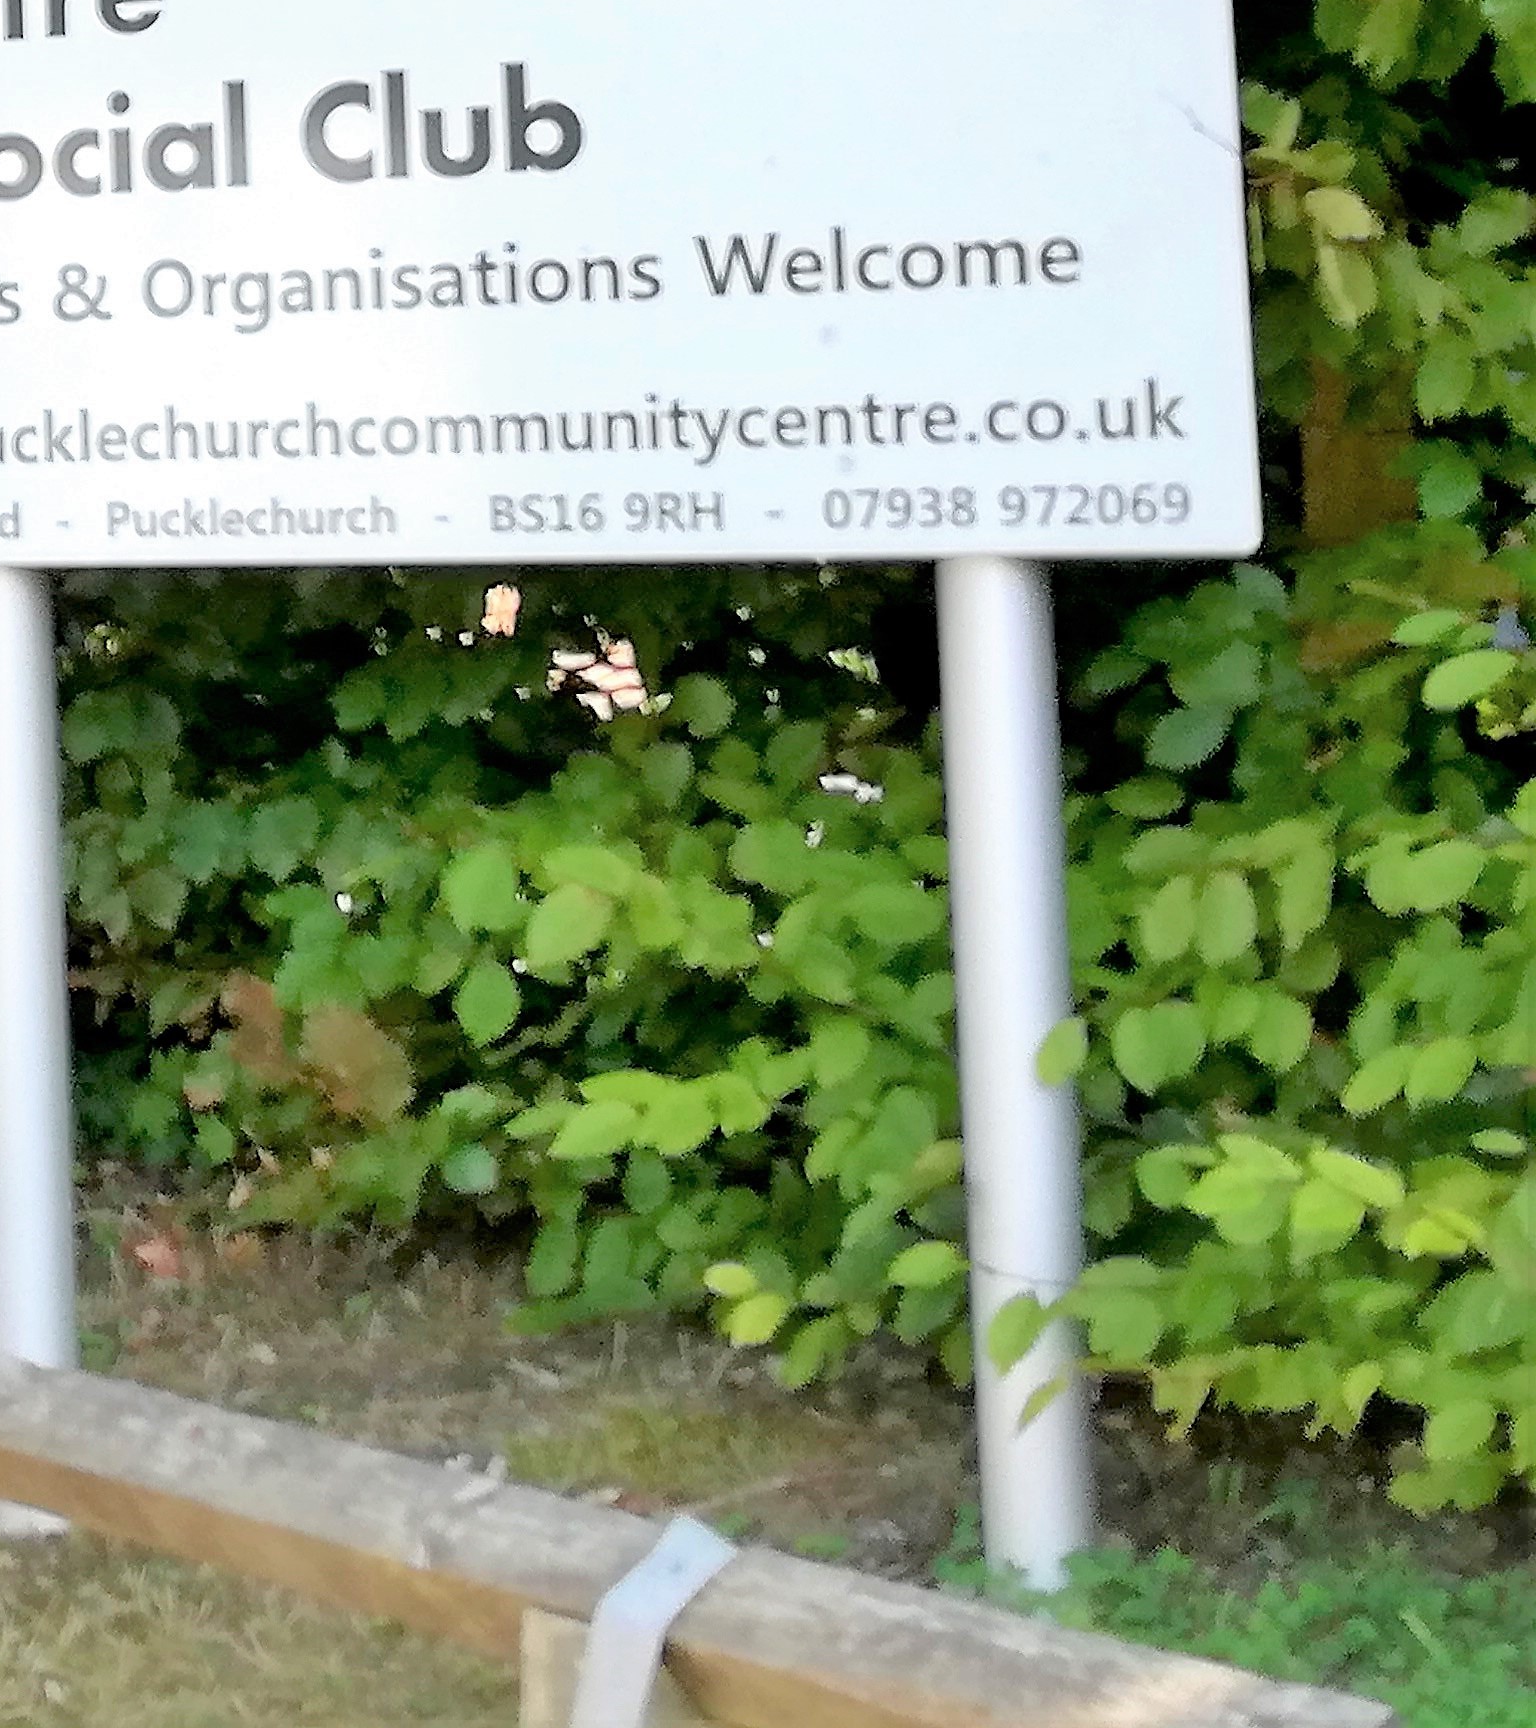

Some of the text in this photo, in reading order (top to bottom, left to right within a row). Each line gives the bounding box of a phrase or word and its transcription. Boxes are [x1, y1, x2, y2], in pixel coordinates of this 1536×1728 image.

[301, 61, 586, 183] Club
[54, 264, 112, 321] &
[143, 241, 664, 334] Organisations
[692, 226, 1083, 297] Welcome
[106, 494, 398, 539] Pucklechurch
[488, 491, 607, 535] BS16
[622, 489, 726, 535] 9RH
[821, 485, 980, 531] 07938
[996, 481, 1192, 528] 972069
